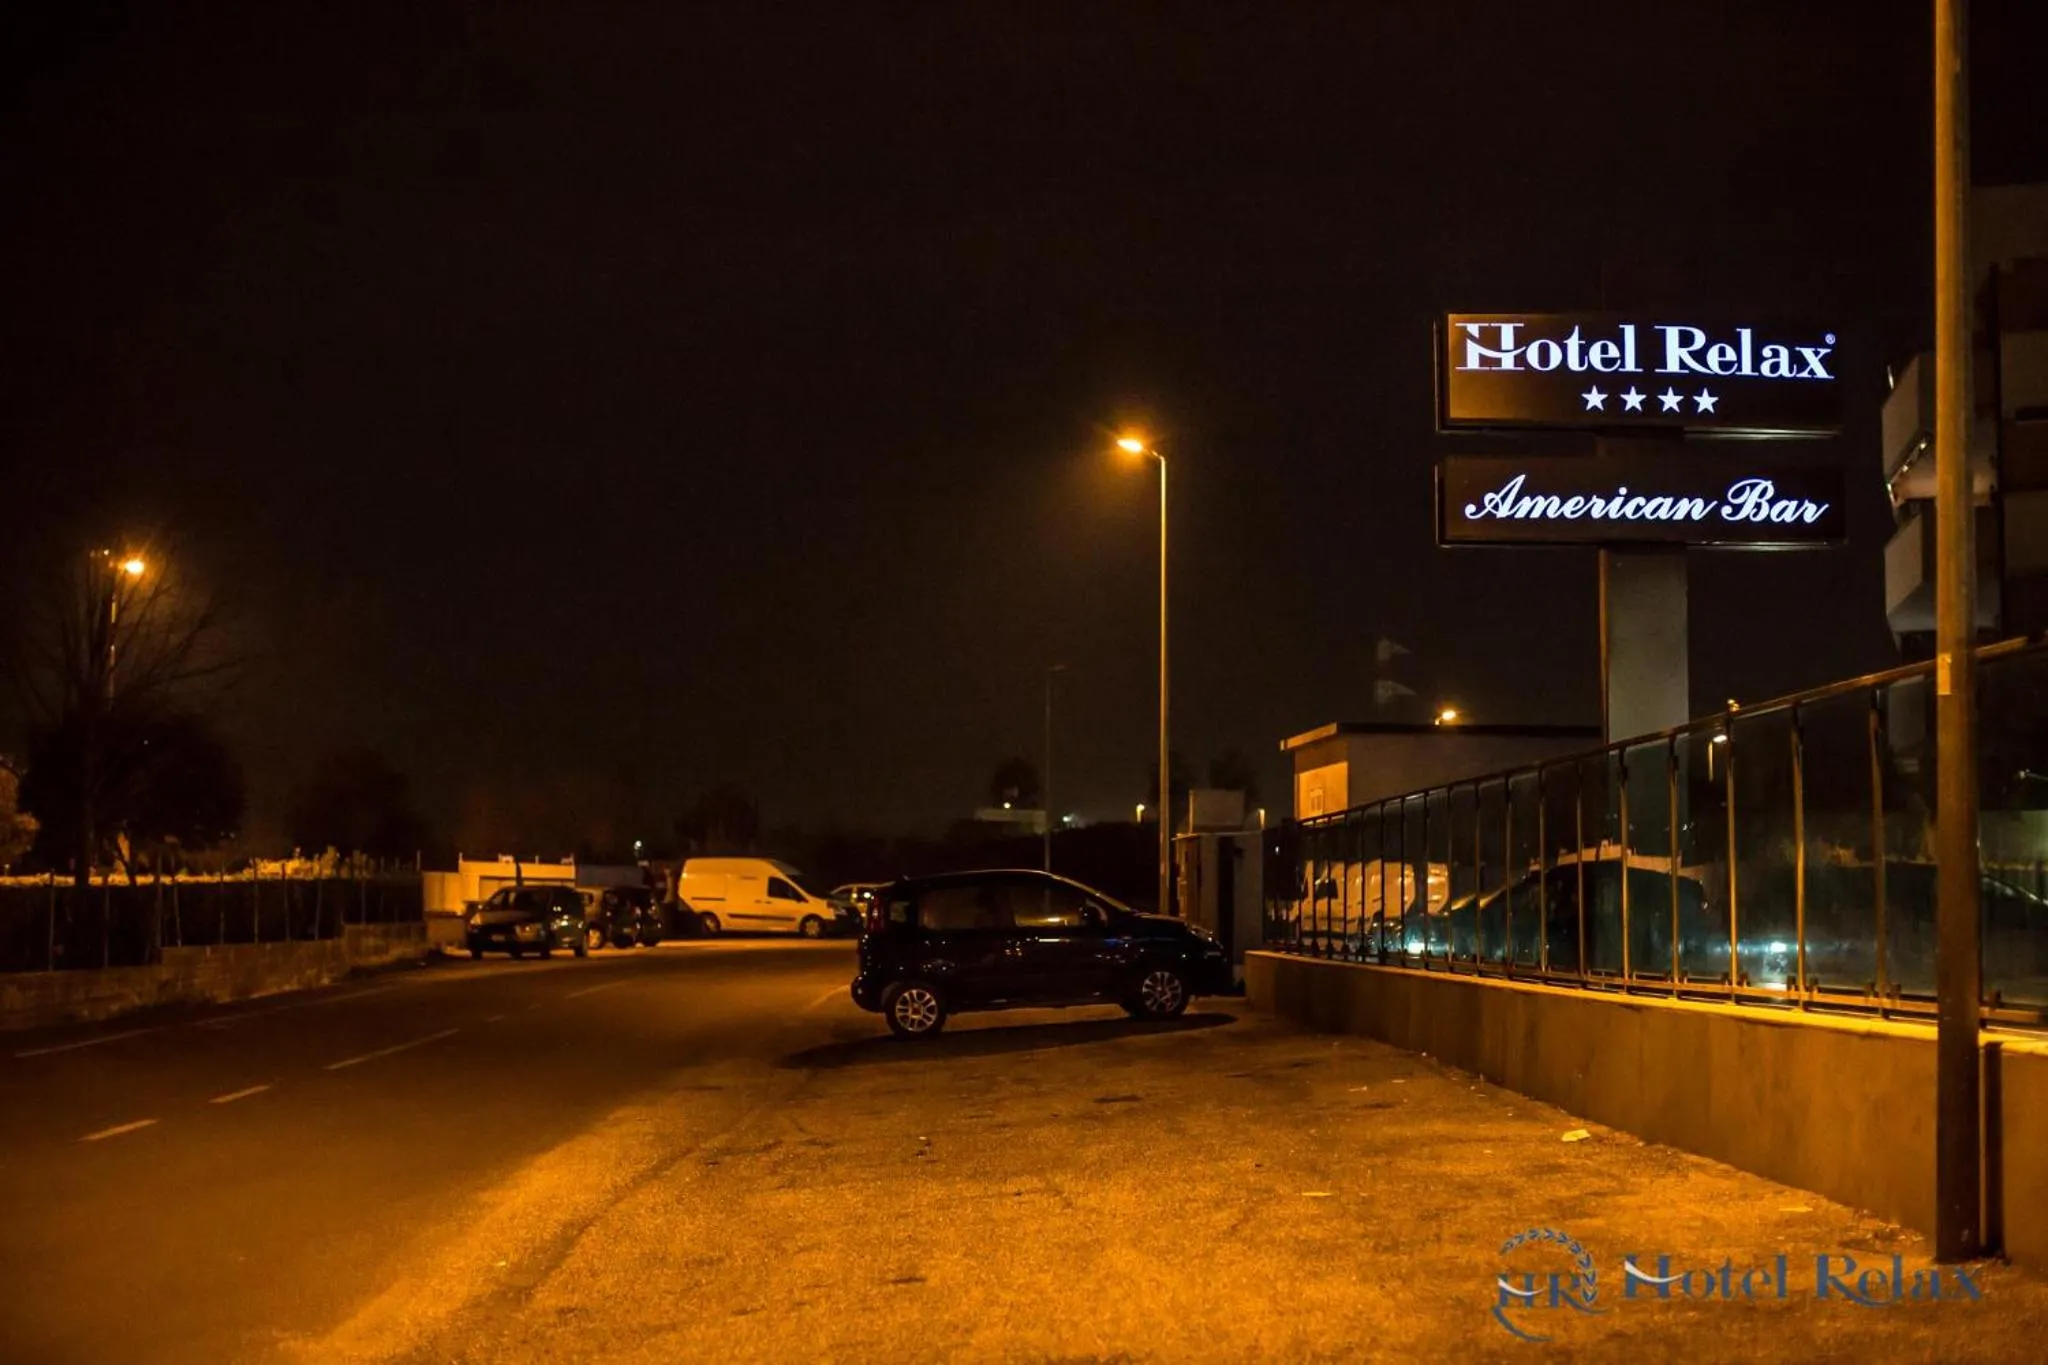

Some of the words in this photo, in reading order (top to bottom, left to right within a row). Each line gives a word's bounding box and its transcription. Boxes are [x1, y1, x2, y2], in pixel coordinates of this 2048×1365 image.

[1455, 322, 1644, 370] Hotel
[1465, 474, 1717, 519] American
[1721, 478, 1829, 523] Bar
